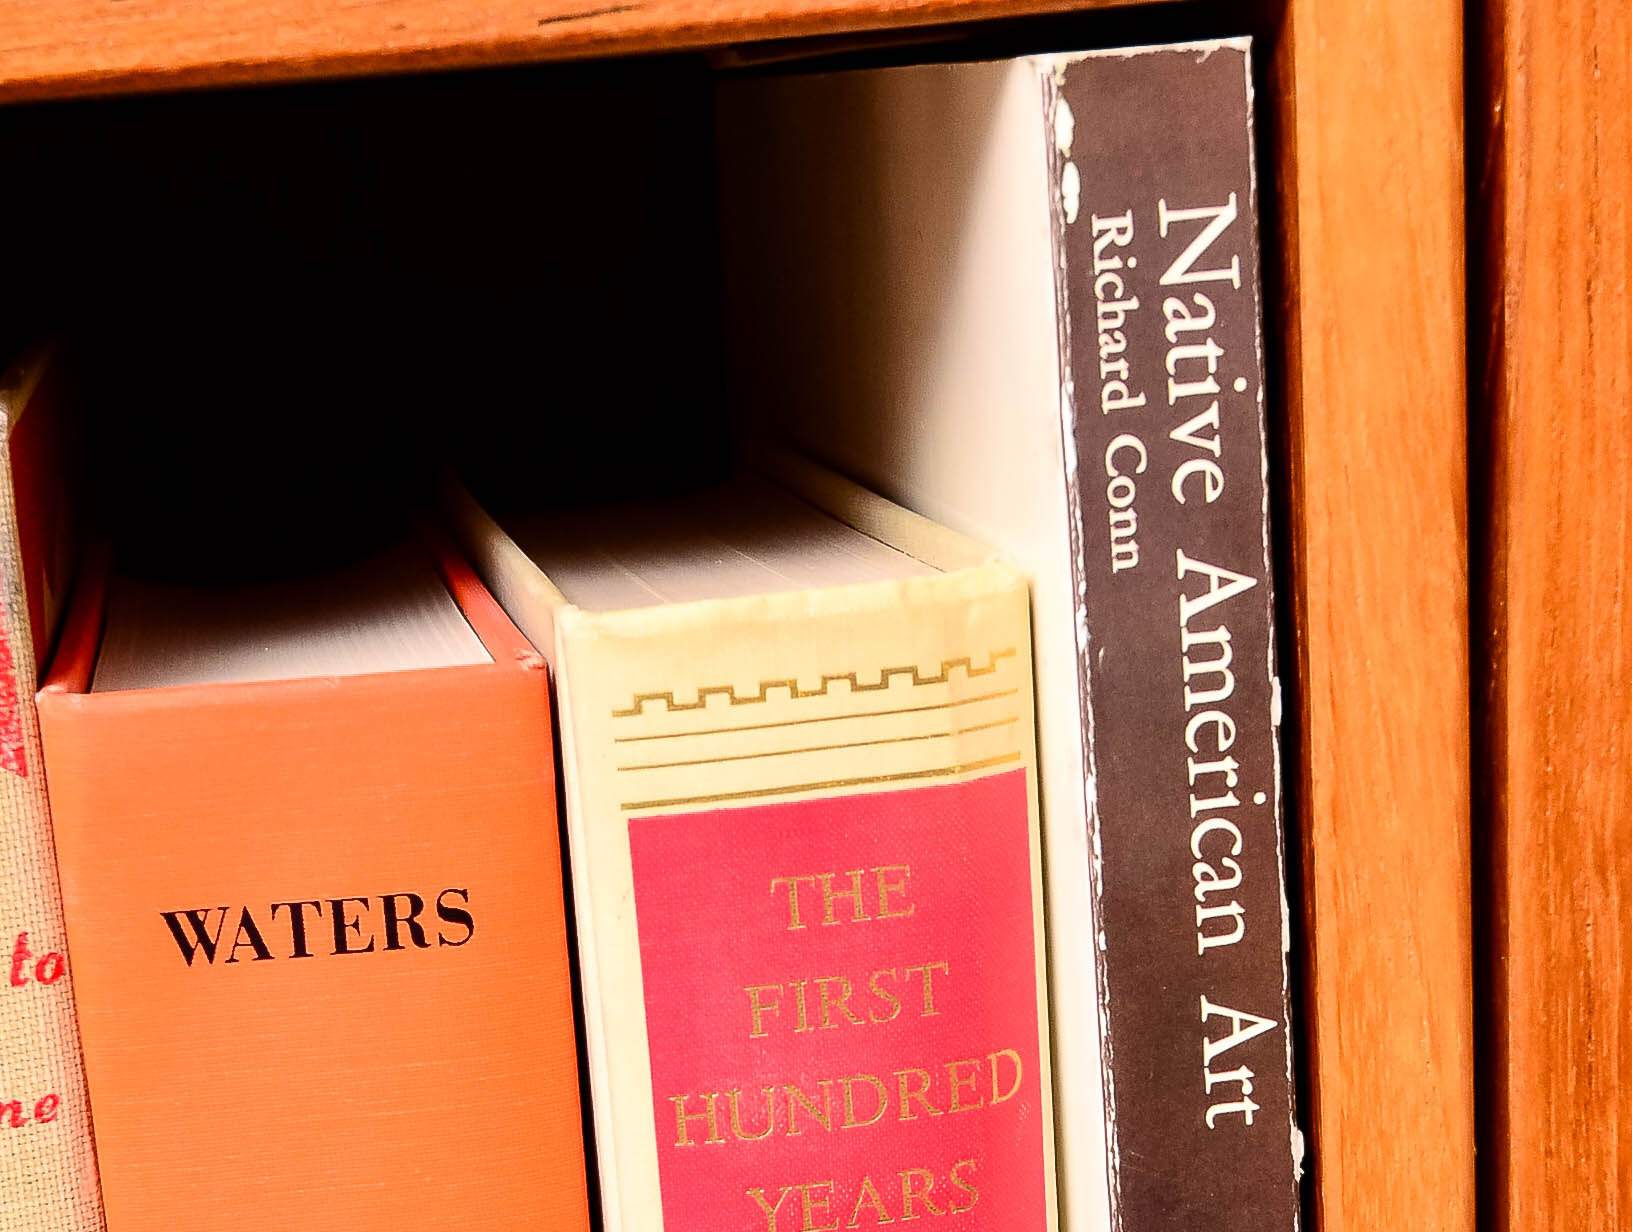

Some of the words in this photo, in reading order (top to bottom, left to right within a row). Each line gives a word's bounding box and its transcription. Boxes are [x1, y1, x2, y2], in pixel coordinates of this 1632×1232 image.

[1090, 208, 1147, 415] Richard
[1157, 190, 1248, 505] Native
[1104, 433, 1148, 574] Conn
[1175, 547, 1267, 957] American
[160, 888, 475, 967] WATERS
[771, 863, 917, 932] THE
[10, 932, 65, 987] to
[745, 961, 950, 1039] FIRST
[670, 1047, 1024, 1150] HUNDRED
[1199, 993, 1278, 1130] Art
